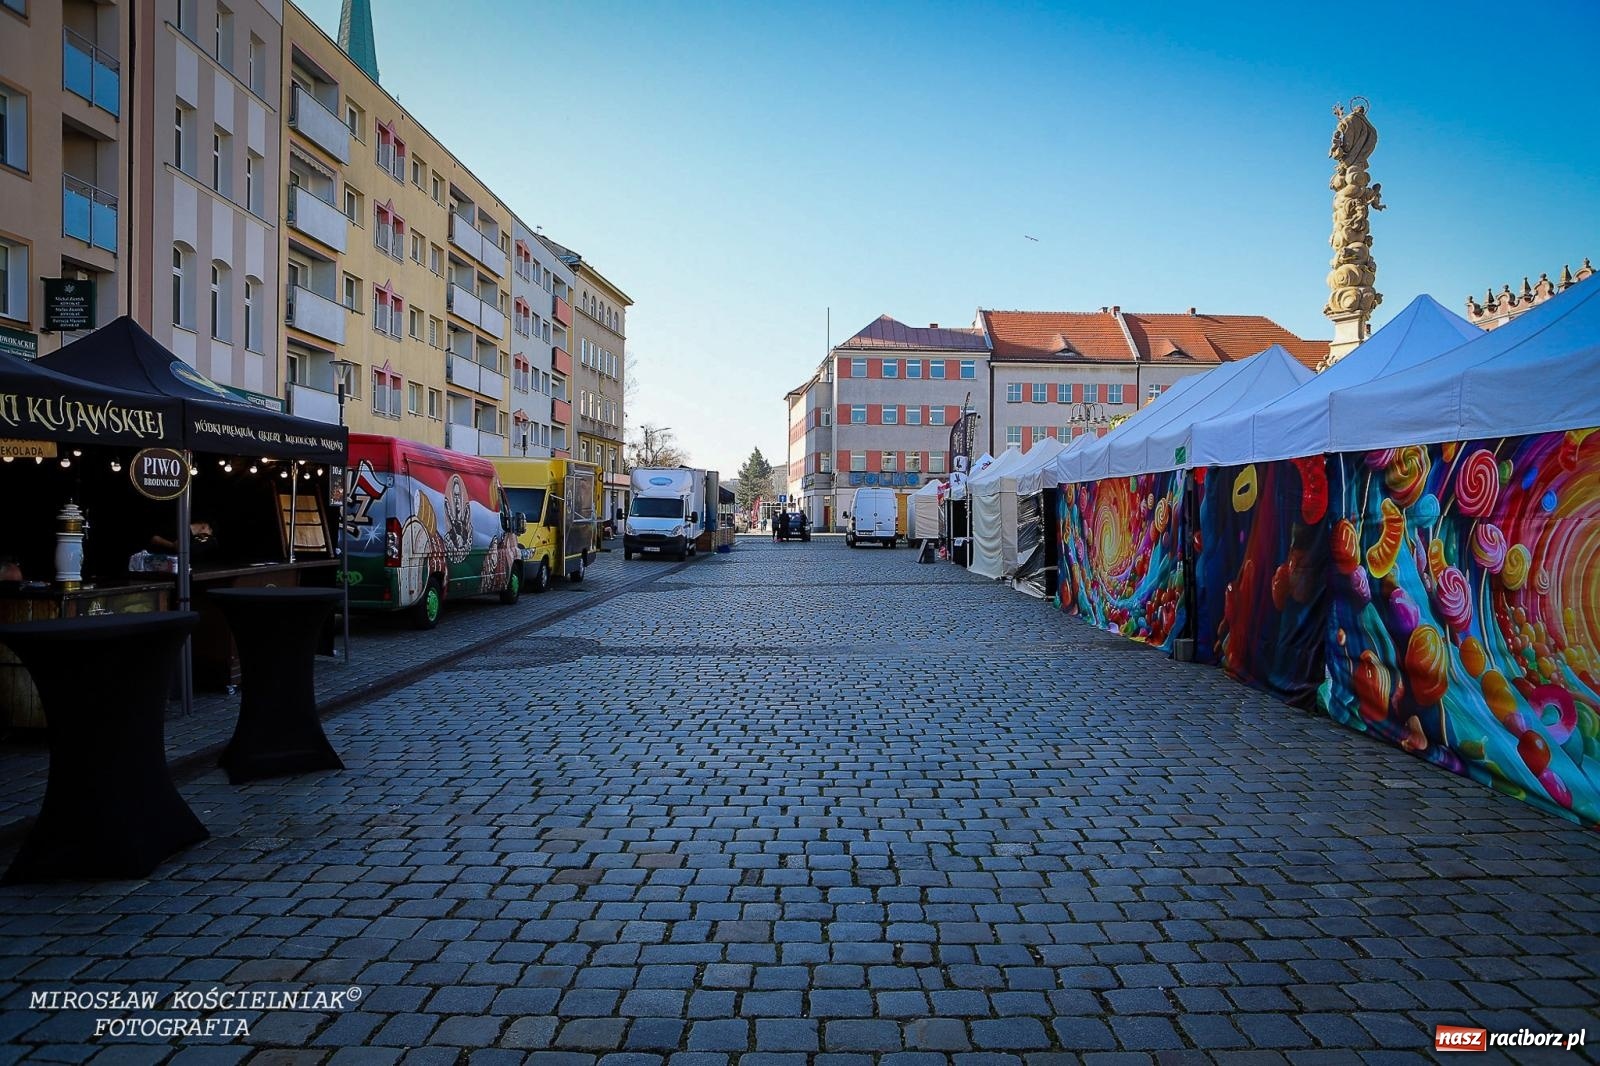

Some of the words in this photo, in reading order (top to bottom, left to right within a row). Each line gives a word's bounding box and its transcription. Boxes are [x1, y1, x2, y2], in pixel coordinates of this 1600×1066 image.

[26, 395, 165, 440] KUJAWSKIEJ
[194, 419, 221, 436] WÓDKI
[221, 424, 256, 440] PREMIUM
[143, 456, 181, 477] PIWO
[143, 477, 181, 488] BRODNICKIE
